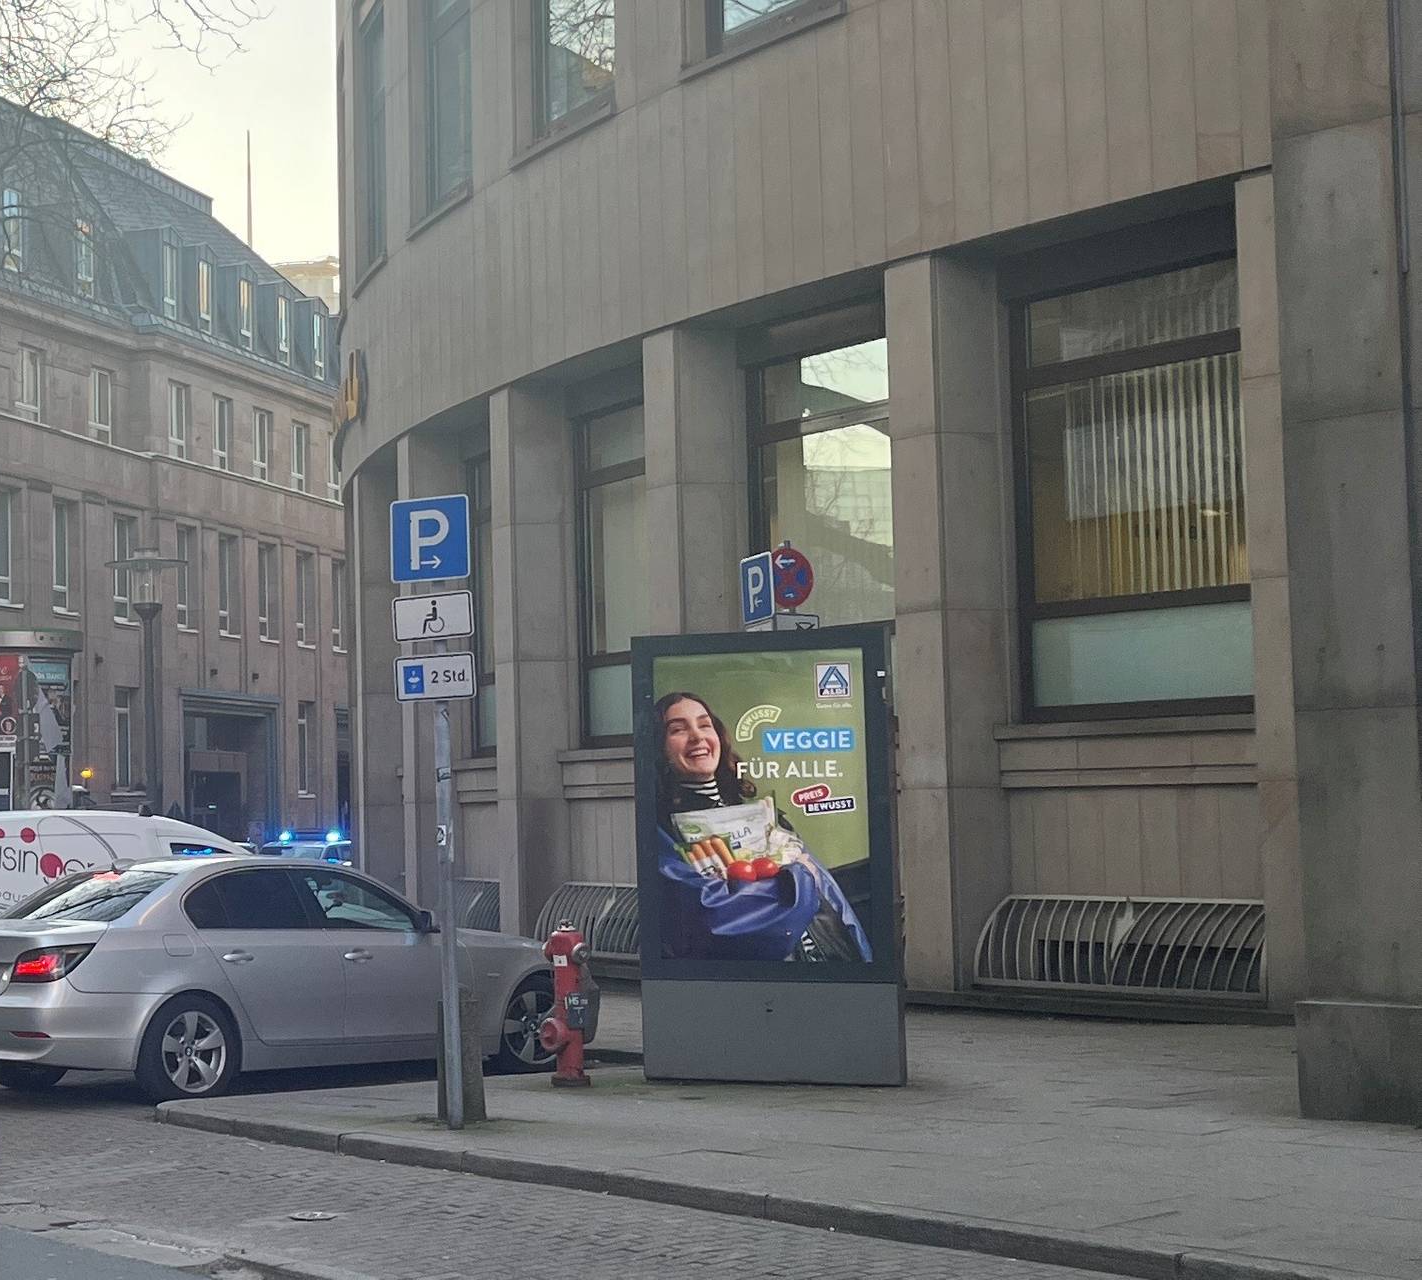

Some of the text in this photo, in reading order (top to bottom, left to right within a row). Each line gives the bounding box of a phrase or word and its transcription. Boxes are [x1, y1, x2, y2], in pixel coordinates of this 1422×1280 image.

[410, 509, 449, 571] P
[748, 565, 764, 614] P
[430, 668, 470, 684] 2 Std.
[822, 688, 847, 696] ALDI
[739, 709, 776, 737] BEWUSST
[766, 731, 851, 749] VEGGIE
[737, 757, 844, 779] FÜR ALLE.
[798, 788, 824, 801] PREIS
[807, 799, 852, 812] BEWUSST
